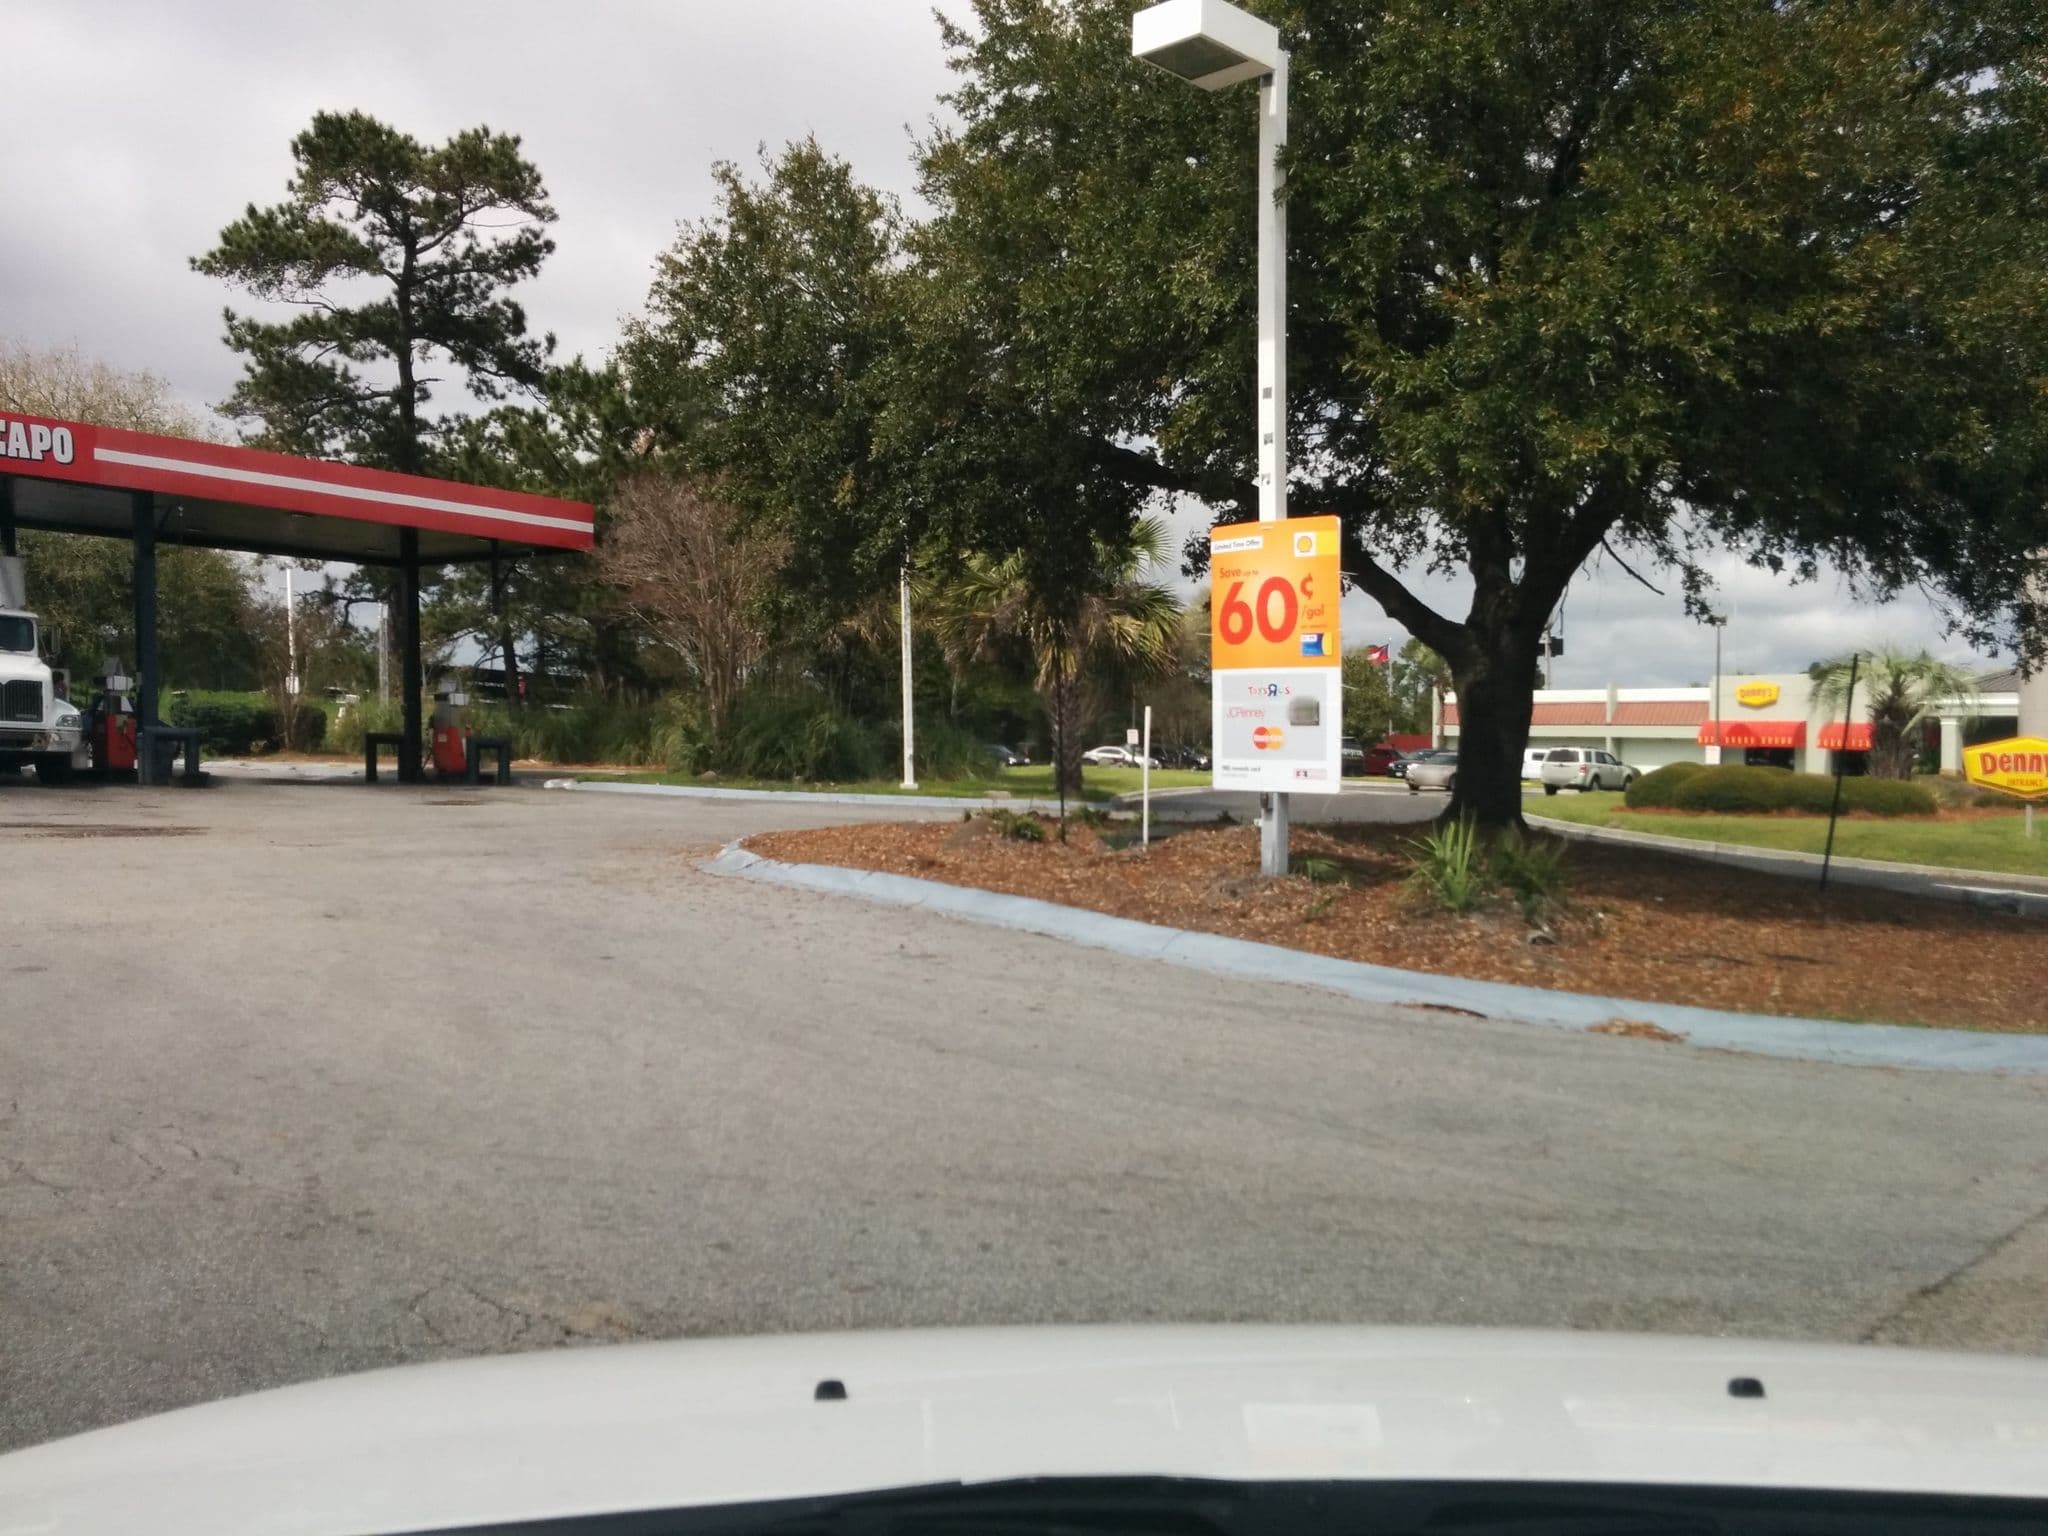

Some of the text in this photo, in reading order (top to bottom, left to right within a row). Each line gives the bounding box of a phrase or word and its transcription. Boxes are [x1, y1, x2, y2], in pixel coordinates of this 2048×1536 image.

[1232, 540, 1245, 549] Time
[1245, 538, 1261, 547] Offer
[1219, 567, 1241, 579] Save
